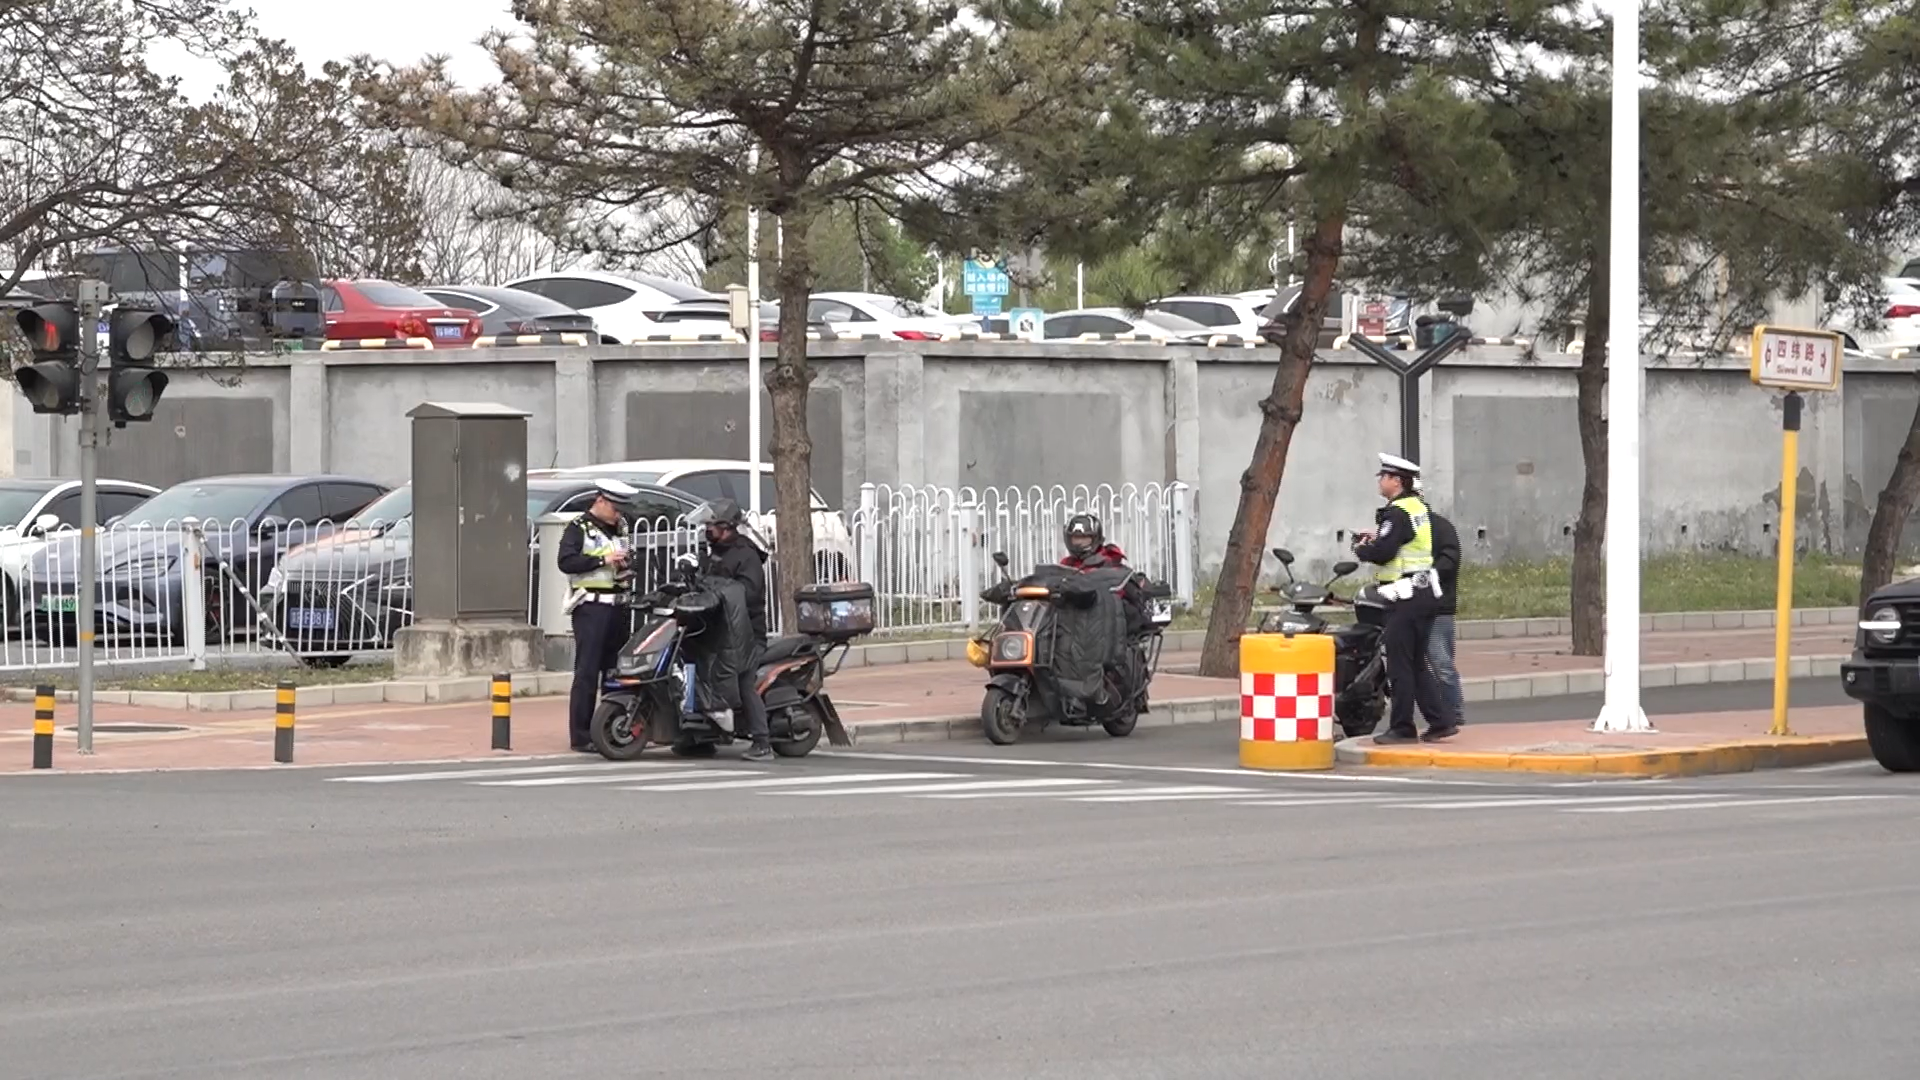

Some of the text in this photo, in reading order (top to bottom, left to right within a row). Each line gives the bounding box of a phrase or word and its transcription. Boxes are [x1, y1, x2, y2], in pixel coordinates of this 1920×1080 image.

[1777, 340, 1814, 361] 四纬路
[1801, 366, 1813, 376] Rd
